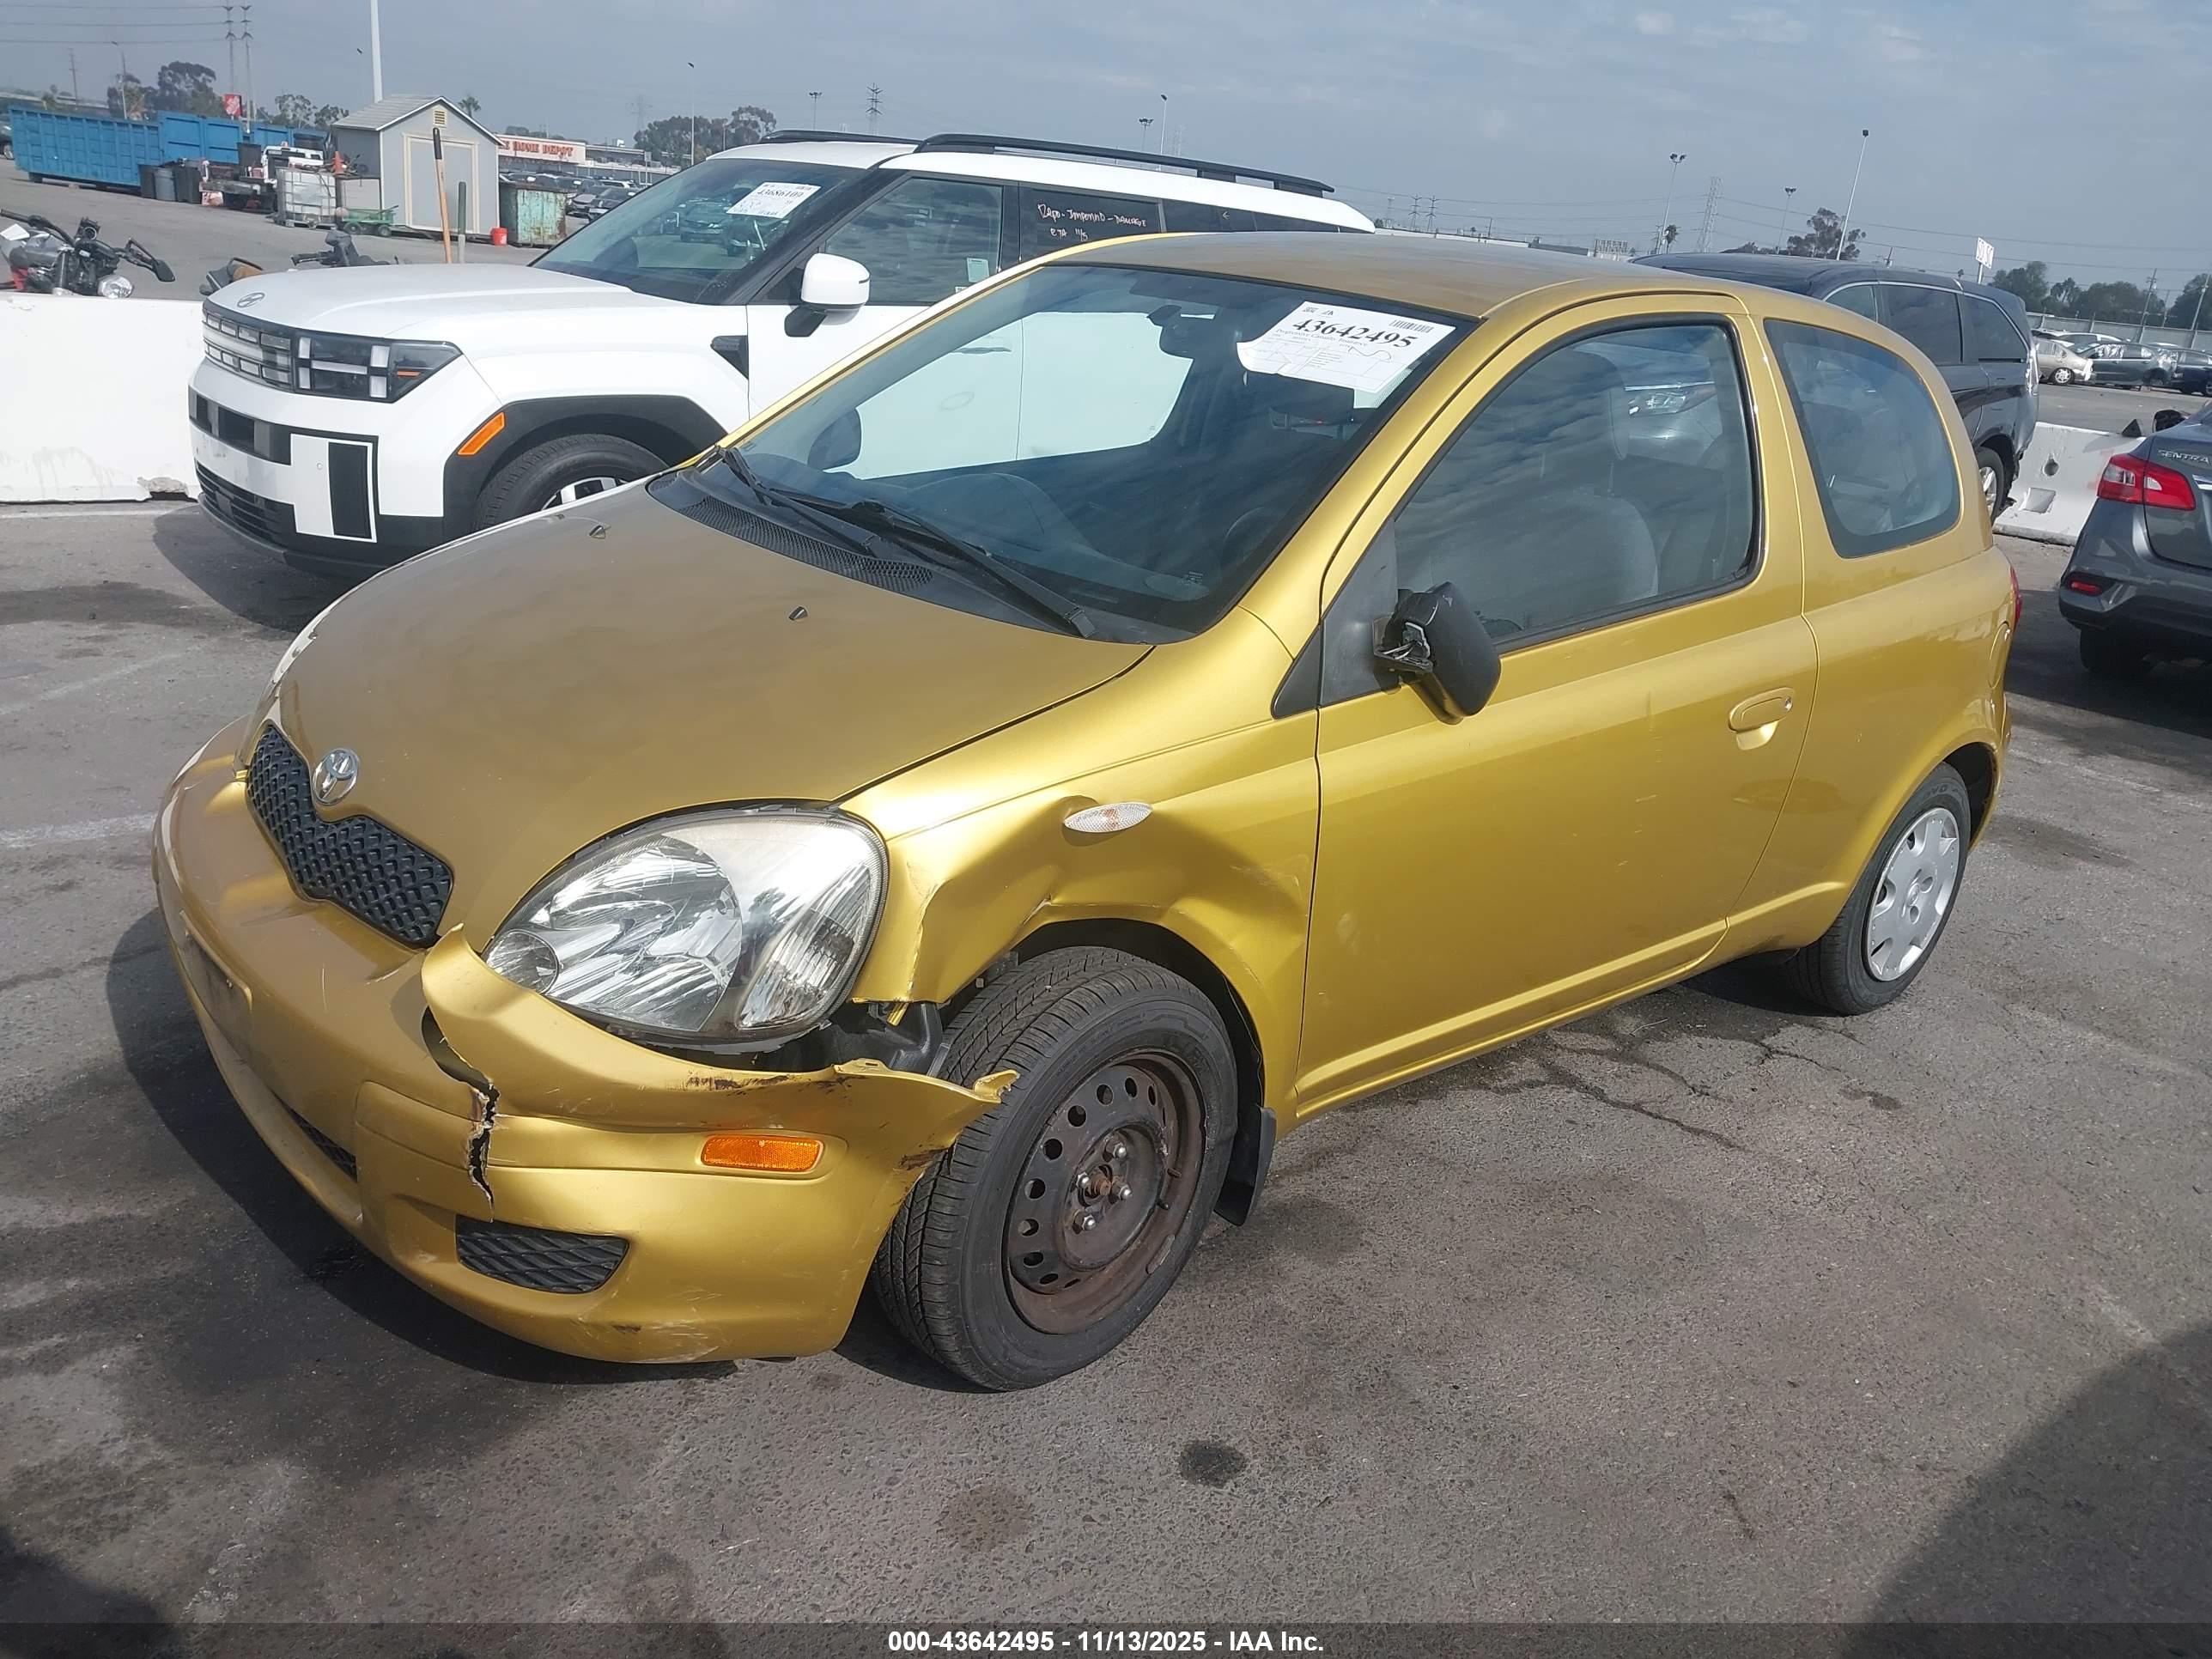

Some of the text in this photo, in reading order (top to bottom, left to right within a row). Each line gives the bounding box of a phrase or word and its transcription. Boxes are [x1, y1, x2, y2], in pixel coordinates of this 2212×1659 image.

[513, 141, 539, 153] HOME
[1292, 319, 1419, 348] 43642495
[2158, 449, 2209, 464] SENTRA
